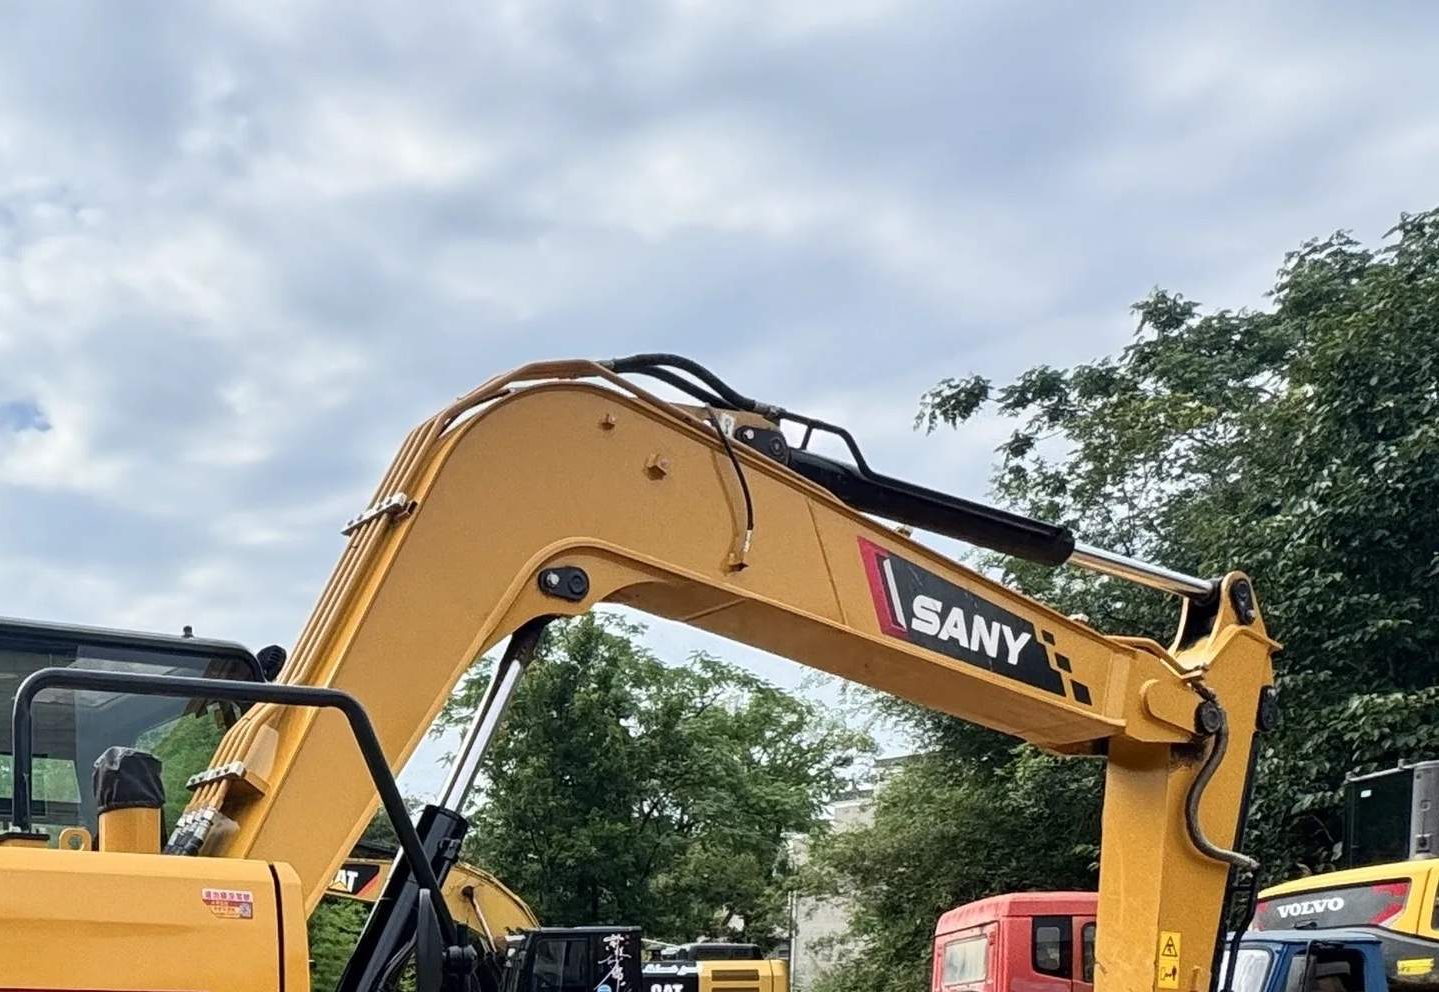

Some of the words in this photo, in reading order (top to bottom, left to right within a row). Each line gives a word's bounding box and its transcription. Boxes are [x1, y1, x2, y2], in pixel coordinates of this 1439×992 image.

[911, 594, 1032, 666] SANY
[329, 869, 359, 892] AT
[1277, 897, 1344, 918] VOLVO
